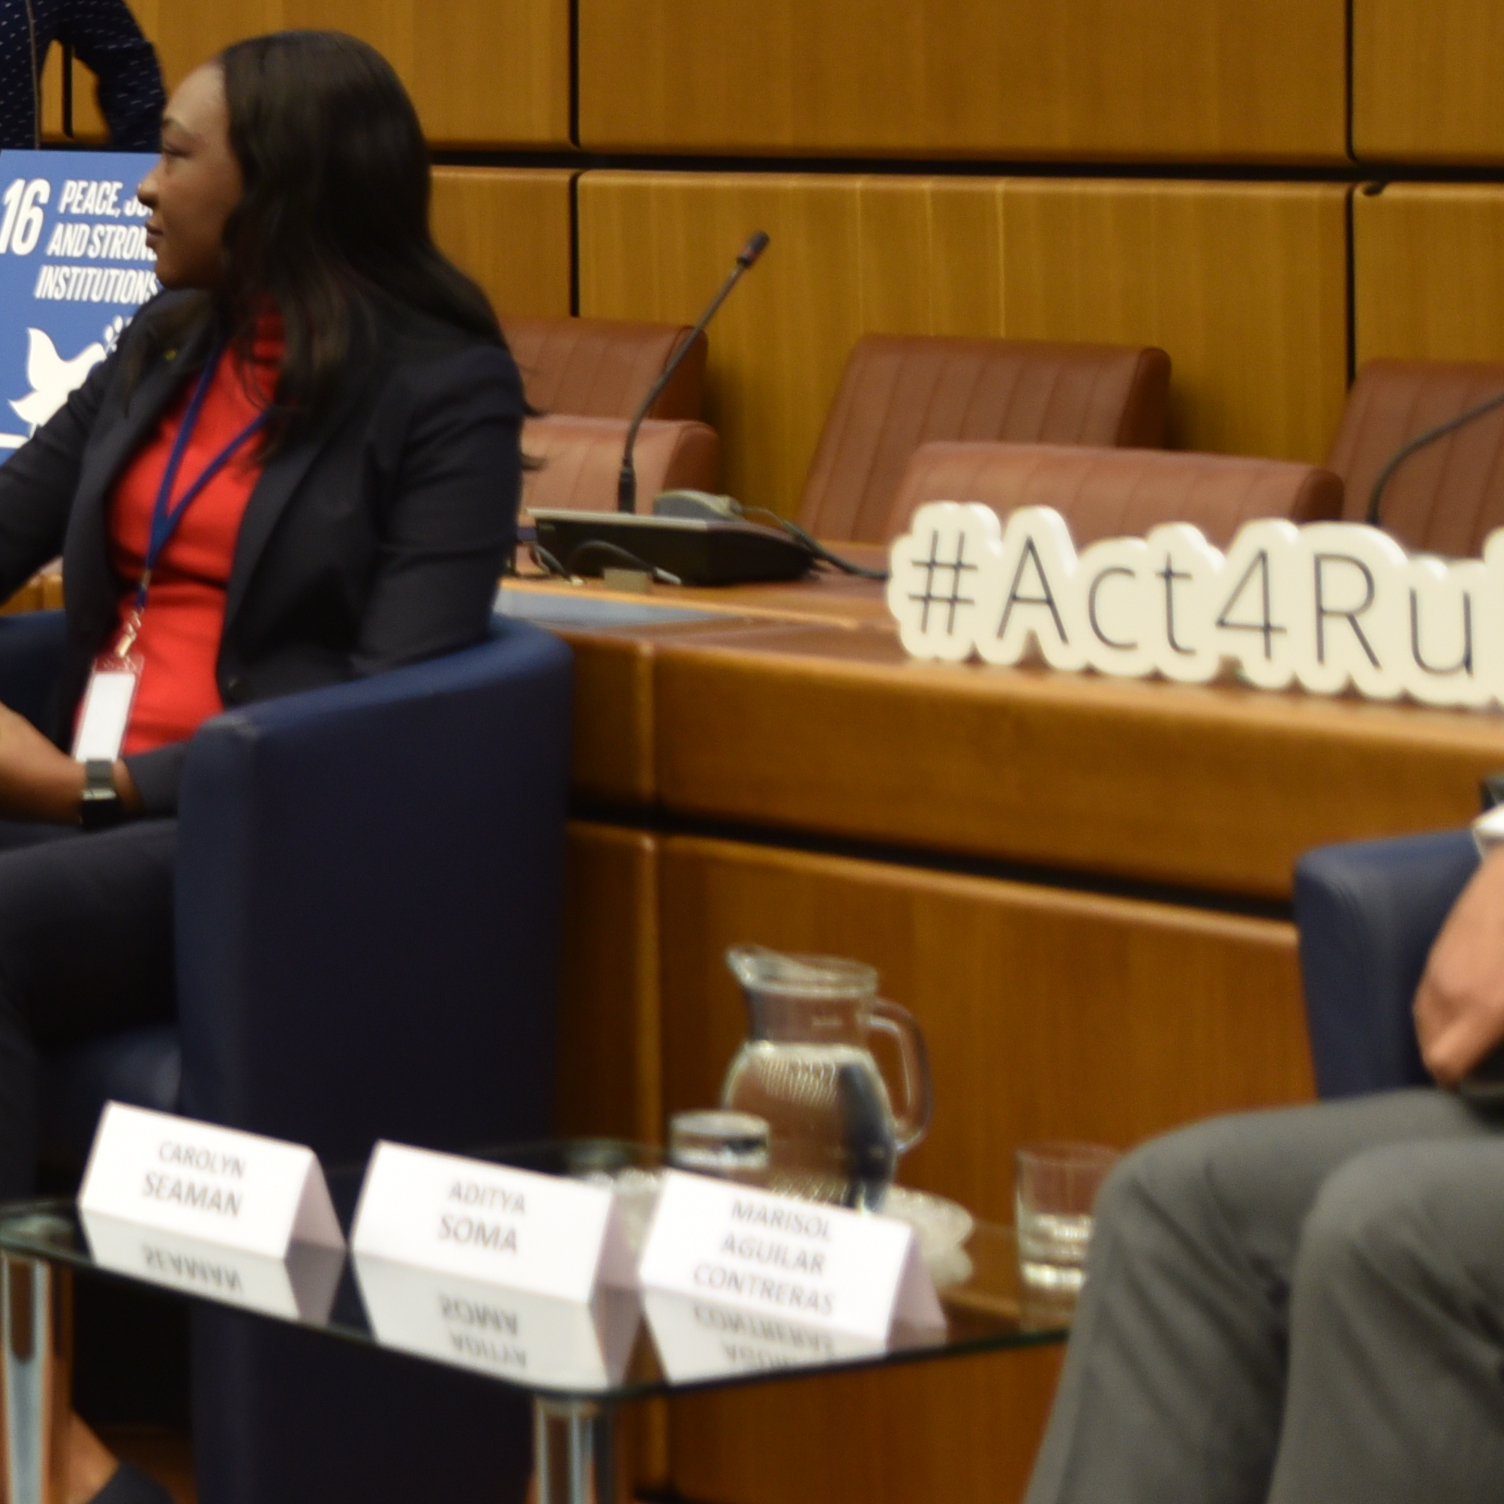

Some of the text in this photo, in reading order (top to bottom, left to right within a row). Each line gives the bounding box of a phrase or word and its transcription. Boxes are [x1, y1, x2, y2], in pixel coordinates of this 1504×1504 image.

[58, 179, 124, 218] PEACE,
[46, 222, 91, 257] AND
[158, 1141, 246, 1178] CAROLYN
[142, 1171, 242, 1218] SEAMAN
[450, 1180, 526, 1214] ADITYA
[437, 1215, 518, 1255] SOMA
[730, 1198, 833, 1242] MARISOL
[720, 1232, 827, 1276] AGUILAR
[693, 1262, 835, 1317] CONTRERAS
